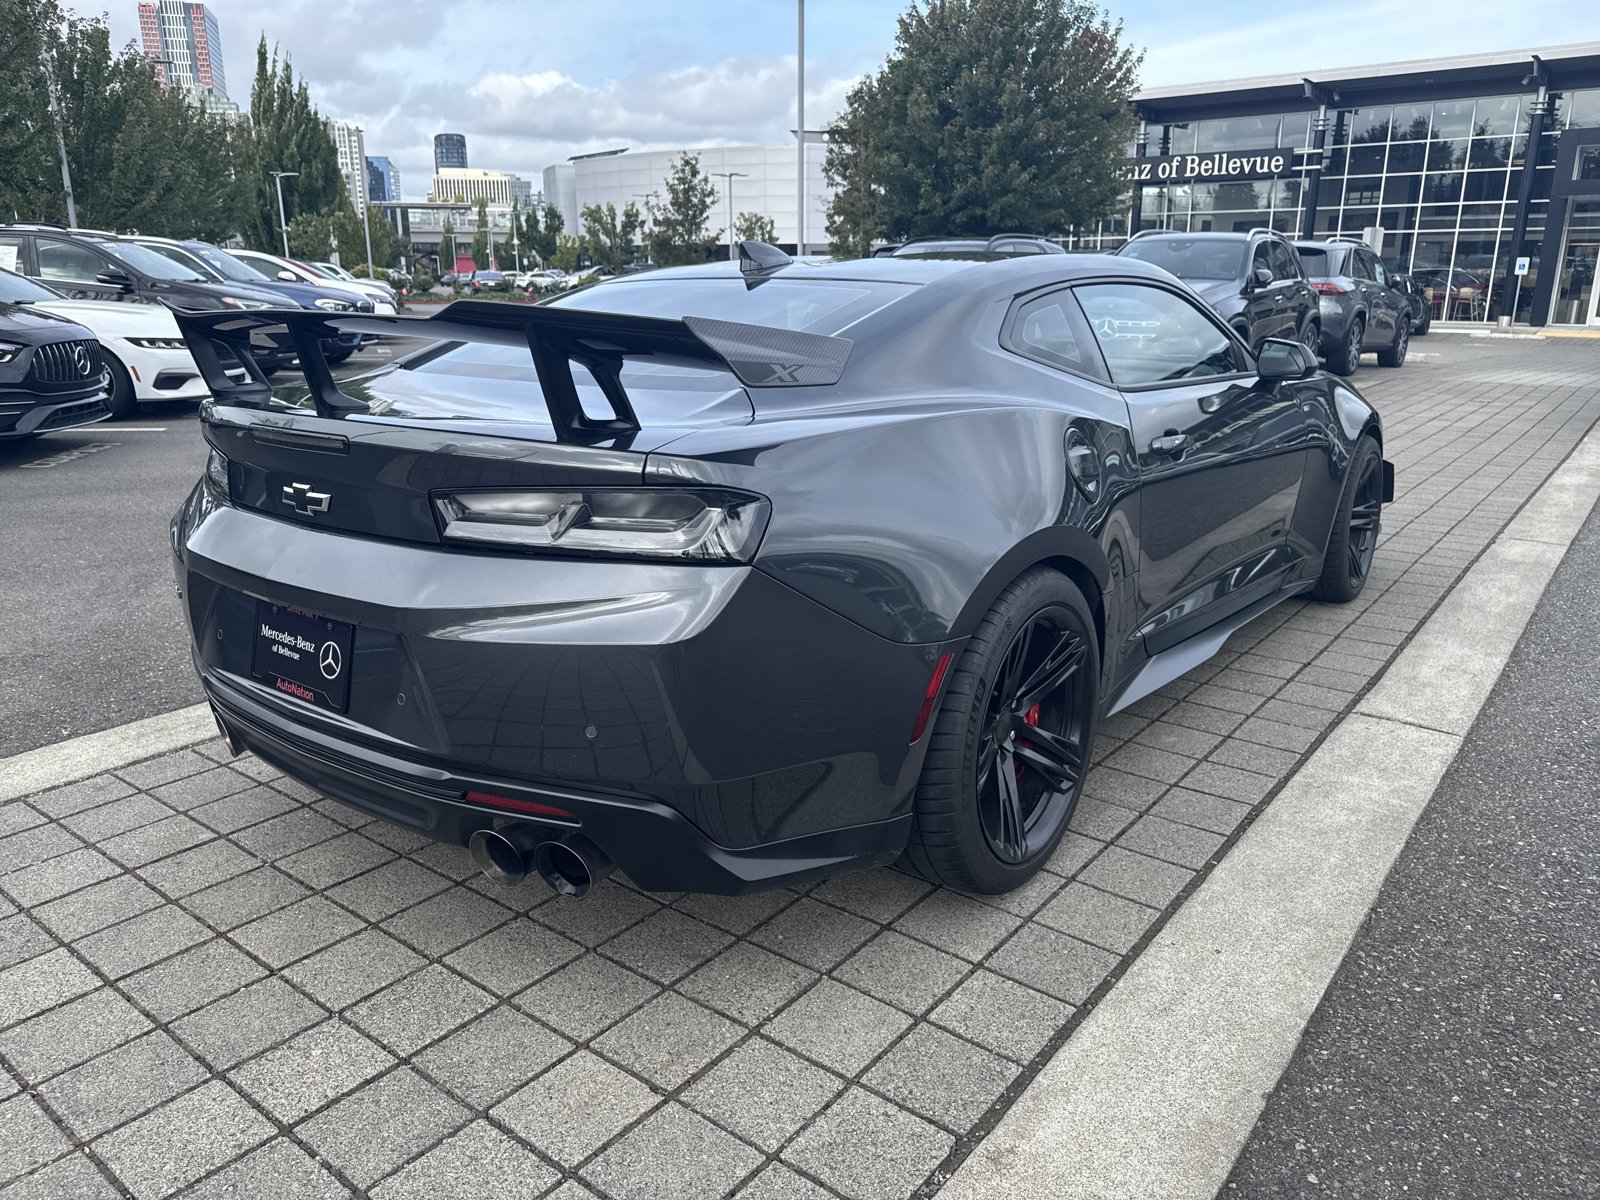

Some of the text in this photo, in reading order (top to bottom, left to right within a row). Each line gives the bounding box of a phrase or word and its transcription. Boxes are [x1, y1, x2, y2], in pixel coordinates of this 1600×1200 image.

[1157, 156, 1182, 179] of
[1184, 153, 1284, 178] Bellevue
[260, 623, 316, 653] Mercedes-Benz
[271, 643, 300, 661] of Bellevue
[276, 677, 314, 702] AutoNation
